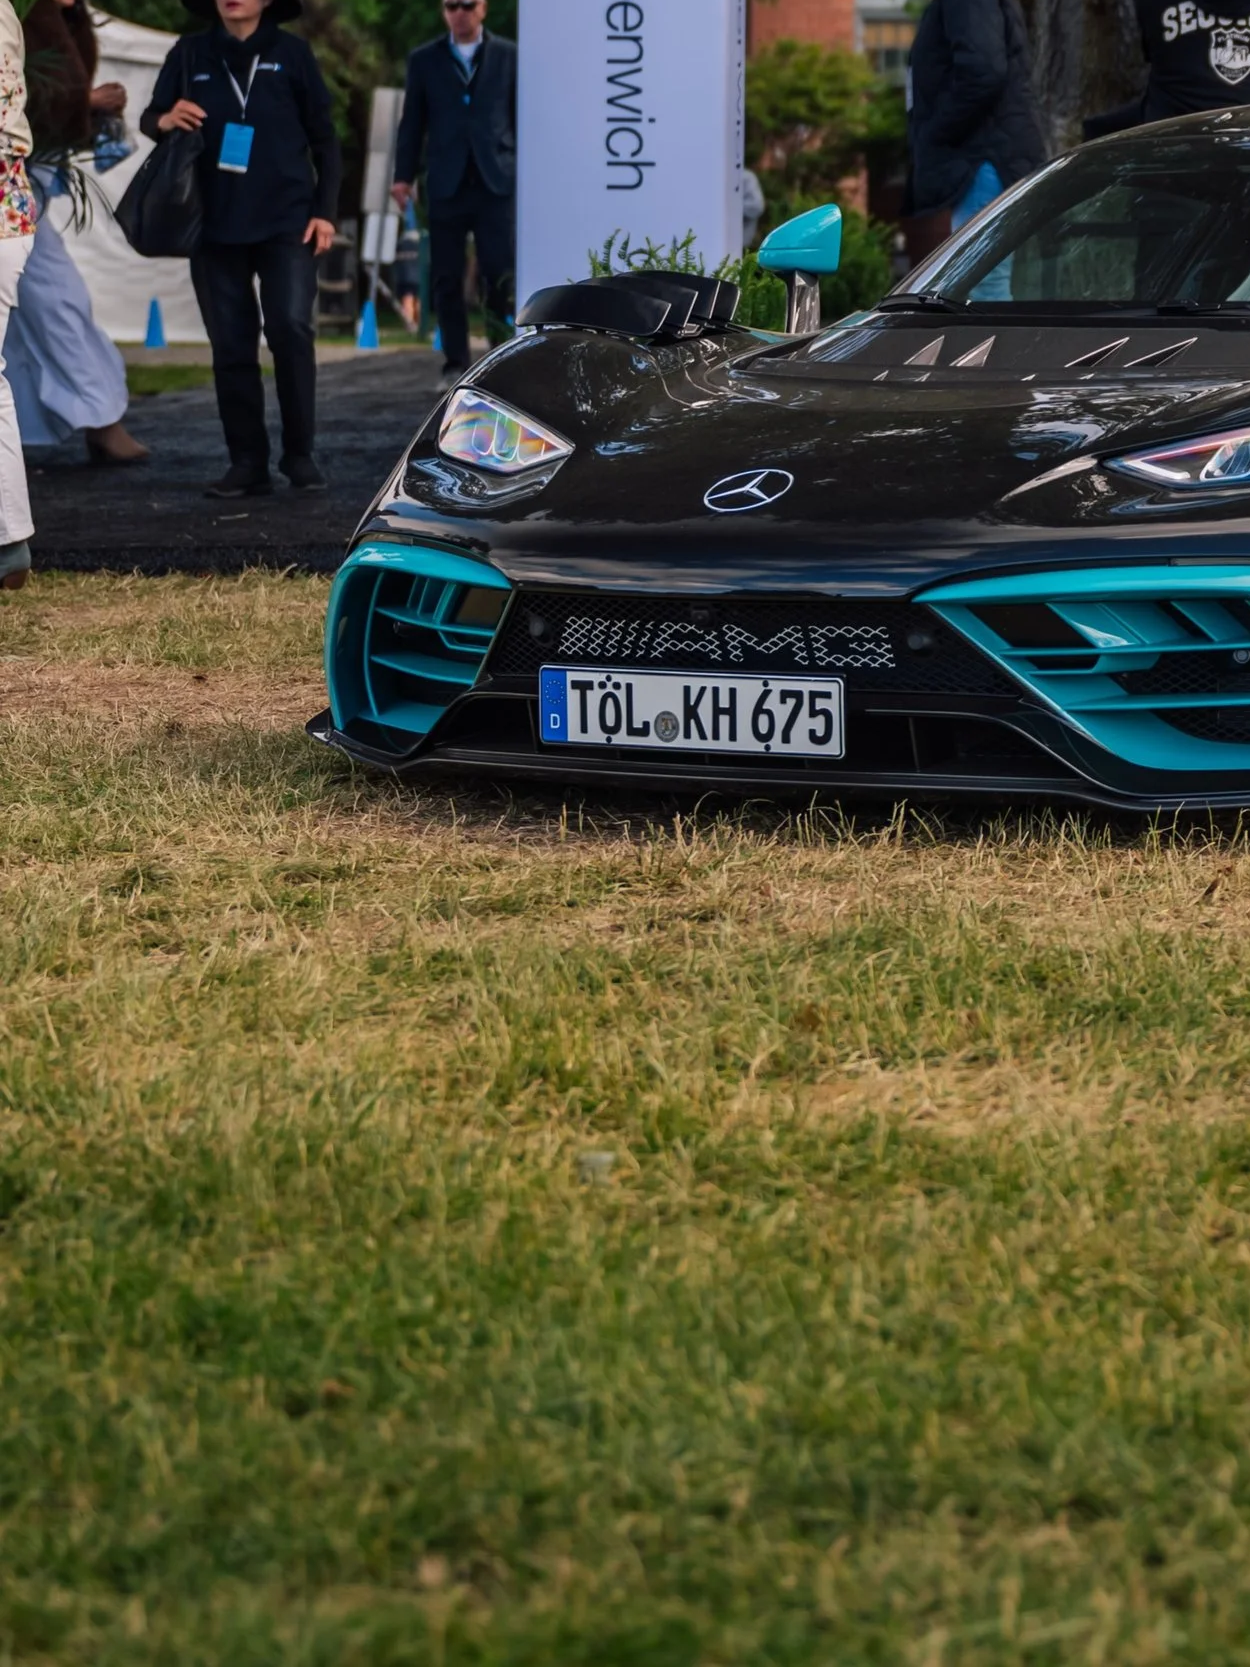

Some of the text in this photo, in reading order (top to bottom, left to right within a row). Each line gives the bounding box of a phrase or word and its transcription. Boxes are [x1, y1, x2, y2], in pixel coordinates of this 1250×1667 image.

[550, 713, 560, 729] D
[570, 679, 650, 738] TÖL
[683, 684, 737, 743] KH
[751, 688, 834, 747] 675
